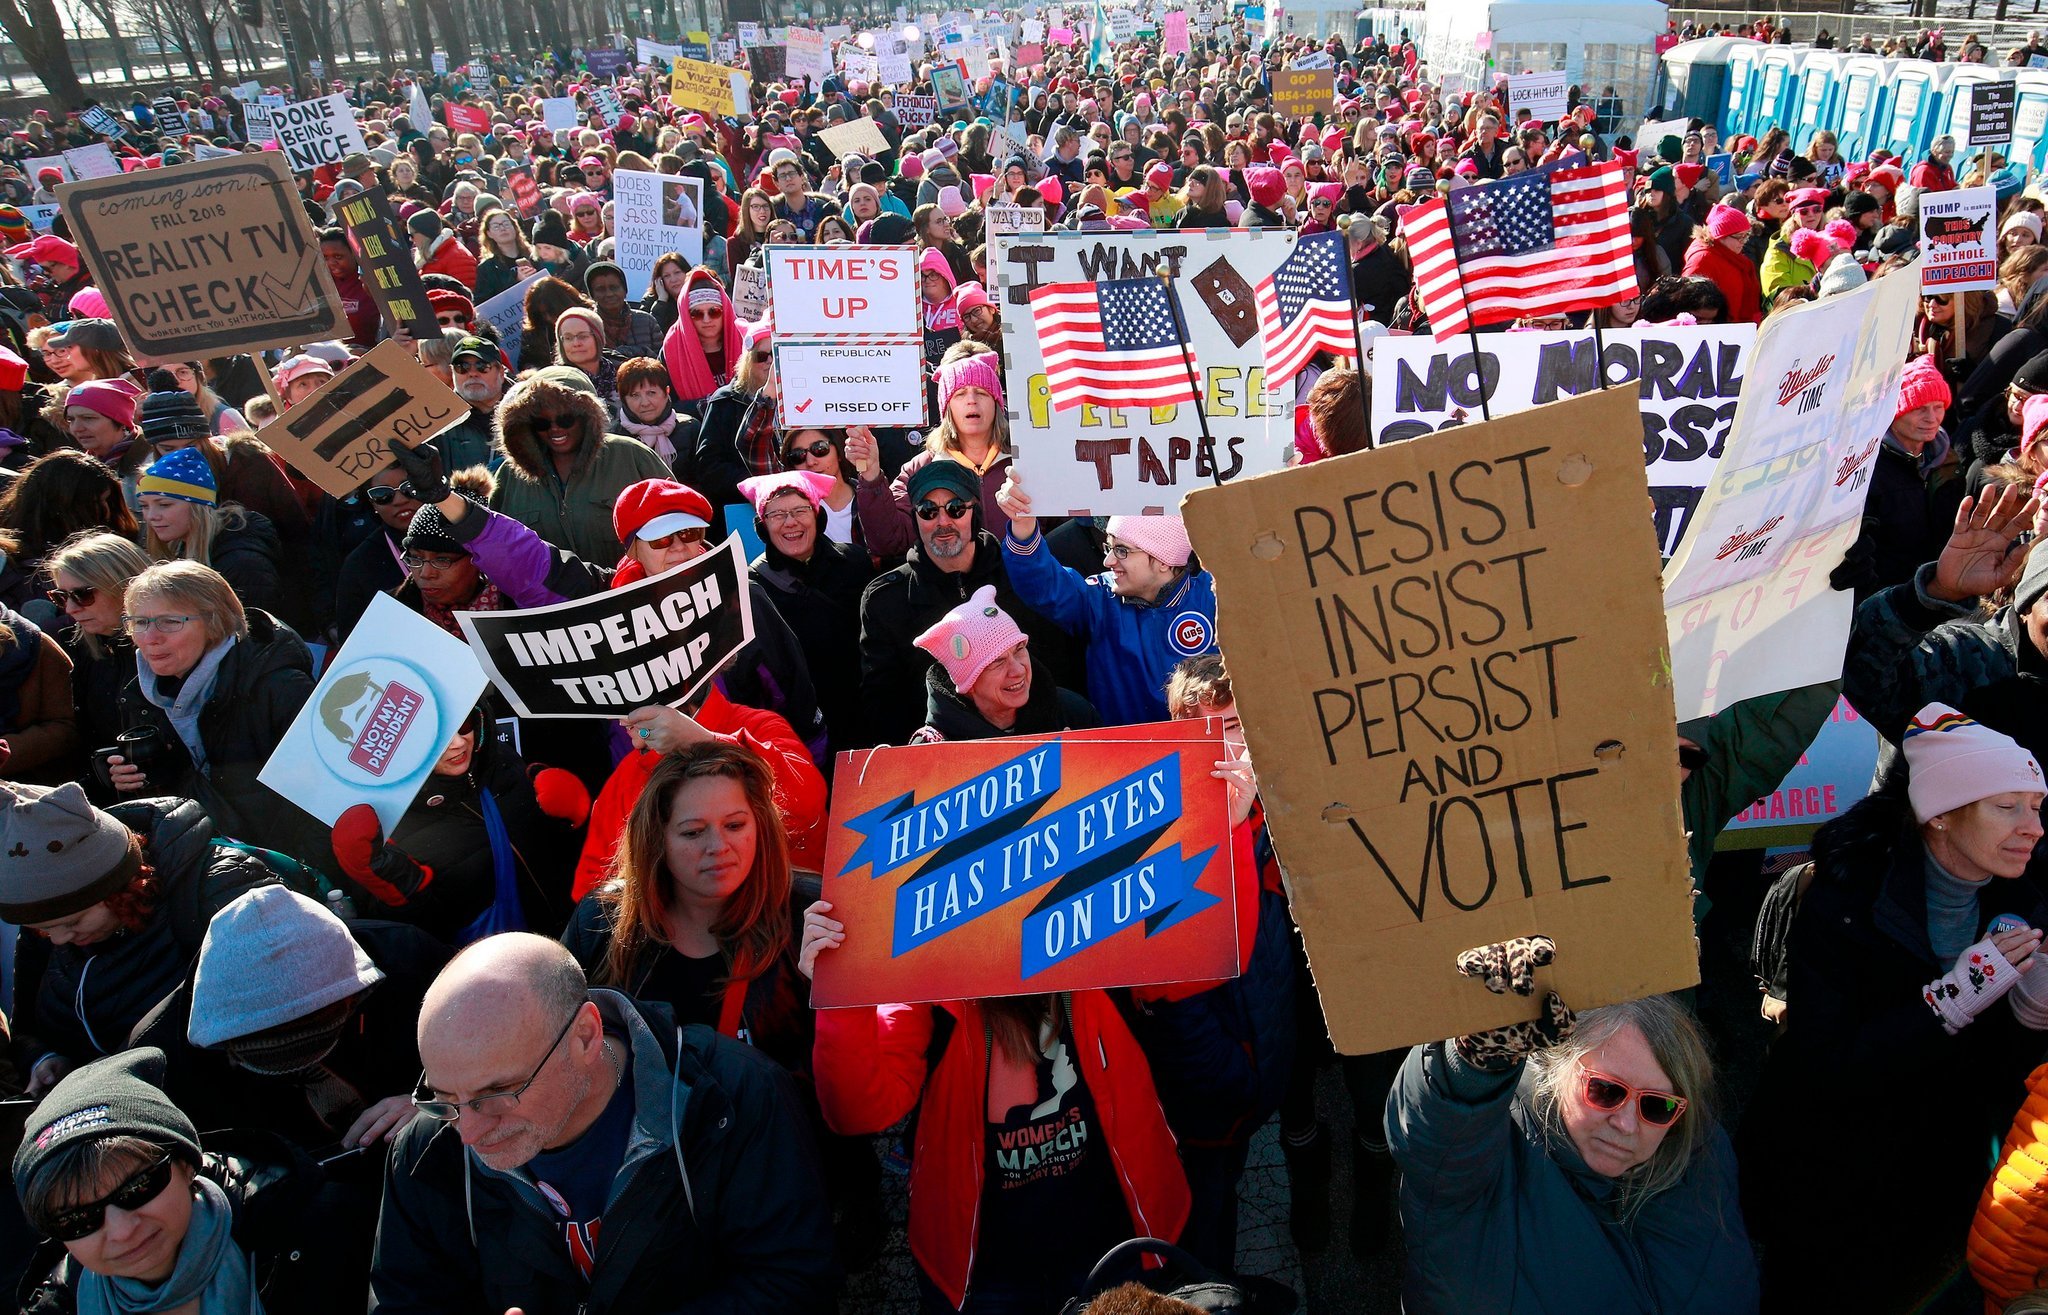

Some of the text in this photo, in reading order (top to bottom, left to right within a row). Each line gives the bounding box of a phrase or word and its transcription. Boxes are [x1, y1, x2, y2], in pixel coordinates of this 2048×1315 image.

[470, 65, 488, 78] NO!
[1290, 74, 1316, 85] GOP
[896, 96, 935, 109] FEMINIST
[1273, 88, 1333, 101] 1854-2018
[1512, 85, 1563, 101] LOCK HIM UP!
[1988, 92, 2000, 100] The
[270, 99, 335, 131] DONE
[1972, 102, 2014, 112] Trump/Pence
[1980, 112, 2005, 121] Regime
[280, 120, 334, 147] BEING
[1976, 121, 2007, 132] MUST GO!
[288, 134, 352, 169] NICE
[98, 176, 259, 217] coming soon!!
[616, 175, 651, 191] DOES
[616, 191, 653, 207] THIS
[1923, 202, 1961, 216] TRUMP
[1971, 203, 1992, 211] making
[151, 204, 226, 232] FALL 2018
[622, 207, 658, 225] ASS
[1944, 219, 1971, 232] THIS
[620, 226, 679, 245] MAKE MY
[1932, 231, 1983, 246] COUNTRY
[101, 221, 289, 282] REALITY TV
[621, 242, 679, 257] COUNTRY
[1076, 242, 1188, 281] WANT
[621, 258, 651, 272] LOOK
[784, 258, 899, 281] TIME'S
[1926, 264, 1992, 281] IMPEACH!
[128, 275, 271, 328] CHECK
[822, 297, 869, 319] UP
[149, 328, 181, 339] WOMEN
[182, 323, 206, 336] VOTE
[206, 316, 225, 329] YOU
[820, 349, 892, 357] REPUBLICAN
[822, 375, 891, 384] DEMOCRATE
[1396, 336, 1744, 412] NO MORAL
[1776, 353, 1836, 407] Mueller
[824, 402, 911, 413] PISSED OFF
[1797, 382, 1827, 416] TIME
[336, 406, 451, 481] FOR ALL
[1074, 436, 1246, 492] TAPES
[1834, 437, 1880, 488] Mueller
[1295, 446, 1552, 588] RESIST
[1714, 514, 1785, 561] Mueller
[1734, 536, 1773, 563] TIME
[504, 572, 723, 667] IMPEACH
[1315, 547, 1547, 678] INSIST
[551, 631, 711, 706] TRUMP
[1313, 635, 1579, 766] PERSIST
[360, 696, 397, 755] NOT MY
[368, 694, 417, 769] PRESIDENT
[1399, 744, 1504, 804] AND
[887, 748, 1050, 867] HISTORY
[911, 768, 1166, 938] HAS ITS EYES
[1347, 768, 1612, 923] VOTE
[1044, 863, 1158, 959] ON US
[53, 1110, 108, 1134] March
[998, 1106, 1082, 1150] WOMEN'S
[996, 1120, 1088, 1170] MARCH
